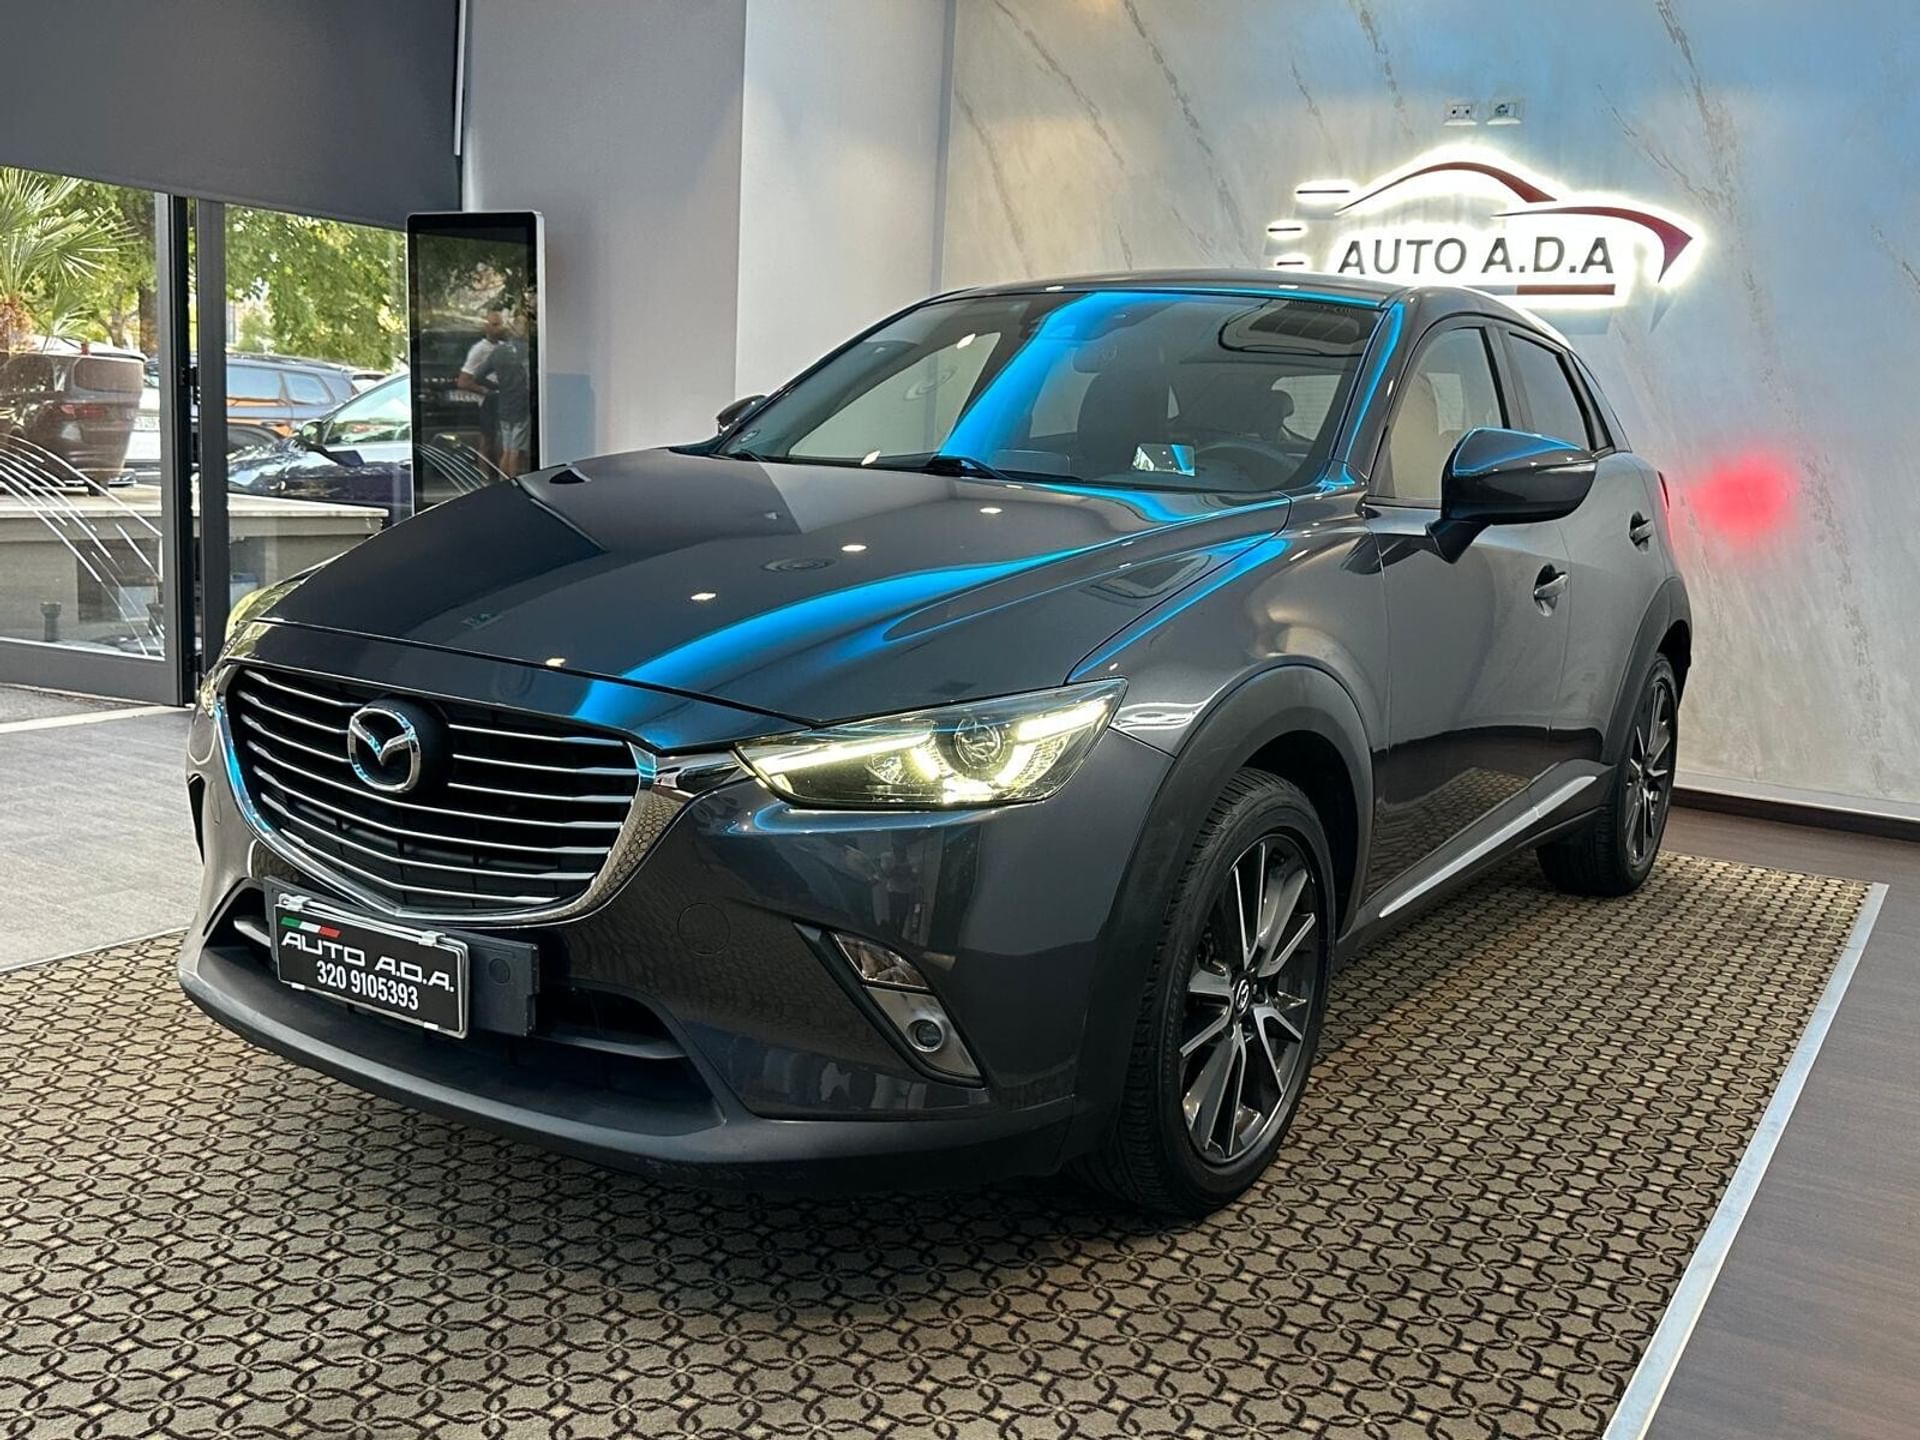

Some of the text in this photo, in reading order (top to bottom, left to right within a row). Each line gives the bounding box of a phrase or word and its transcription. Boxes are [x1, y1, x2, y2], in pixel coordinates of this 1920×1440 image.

[1338, 237, 1614, 275] AUTO A.D.A
[281, 931, 455, 992] AUTO A.D.A.
[316, 960, 419, 1011] 320 9105393
